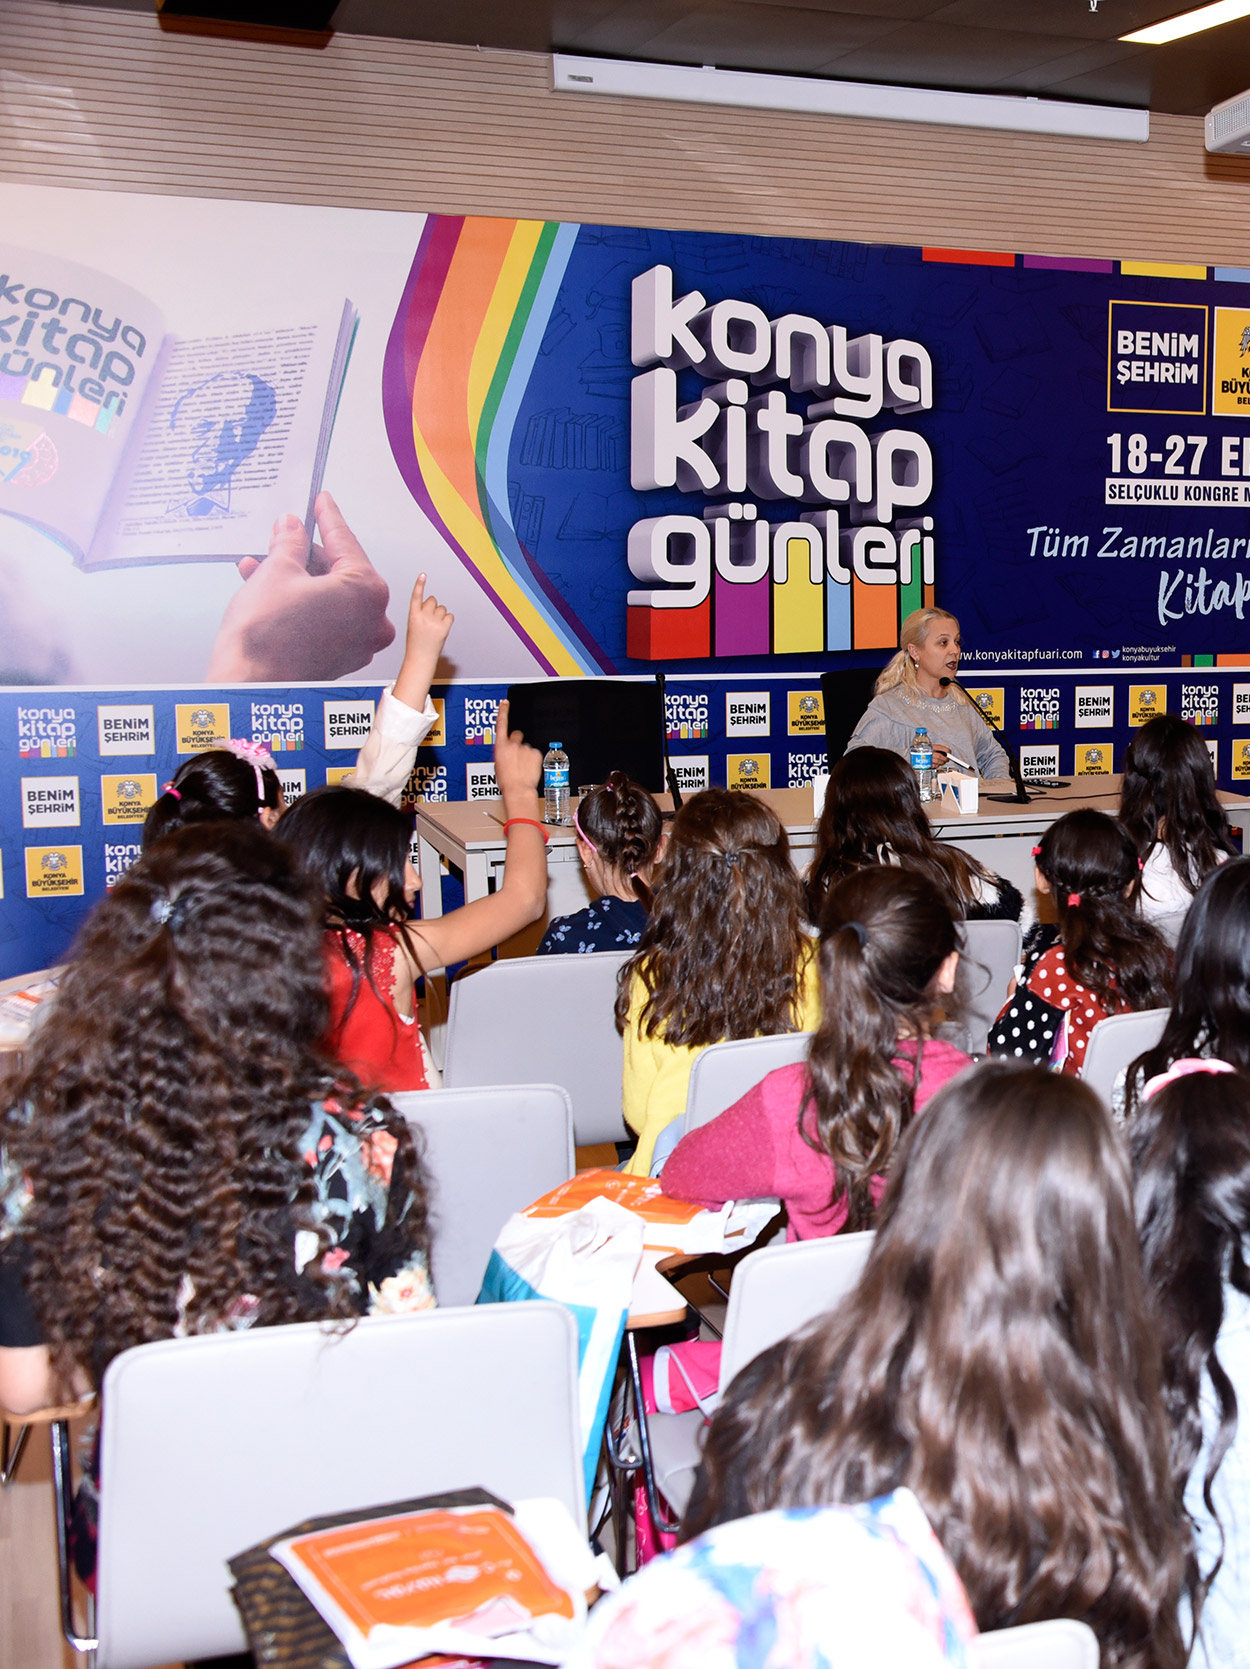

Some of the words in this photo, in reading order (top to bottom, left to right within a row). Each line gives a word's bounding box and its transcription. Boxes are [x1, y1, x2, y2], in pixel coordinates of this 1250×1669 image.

[0, 274, 146, 358] konya
[632, 264, 932, 419] konya
[0, 349, 128, 416] ünleri
[631, 367, 933, 523] kitap
[1107, 433, 1208, 475] 18-27
[1108, 484, 1178, 502] SELÇUKLU
[1184, 486, 1239, 502] KONGRE
[1027, 526, 1089, 558] Tüm
[627, 502, 934, 609] günleri
[1020, 687, 1060, 701] konya
[1182, 684, 1219, 697] konya
[251, 702, 303, 718] konya
[1020, 699, 1060, 713] kitap
[1182, 695, 1219, 709] kitap
[18, 706, 75, 722] konya
[1020, 711, 1060, 725] günleri
[1181, 708, 1218, 721] günleri
[19, 720, 76, 737] kitap
[252, 716, 303, 732] kitap
[19, 736, 76, 752] günleri
[252, 730, 304, 744] günleri
